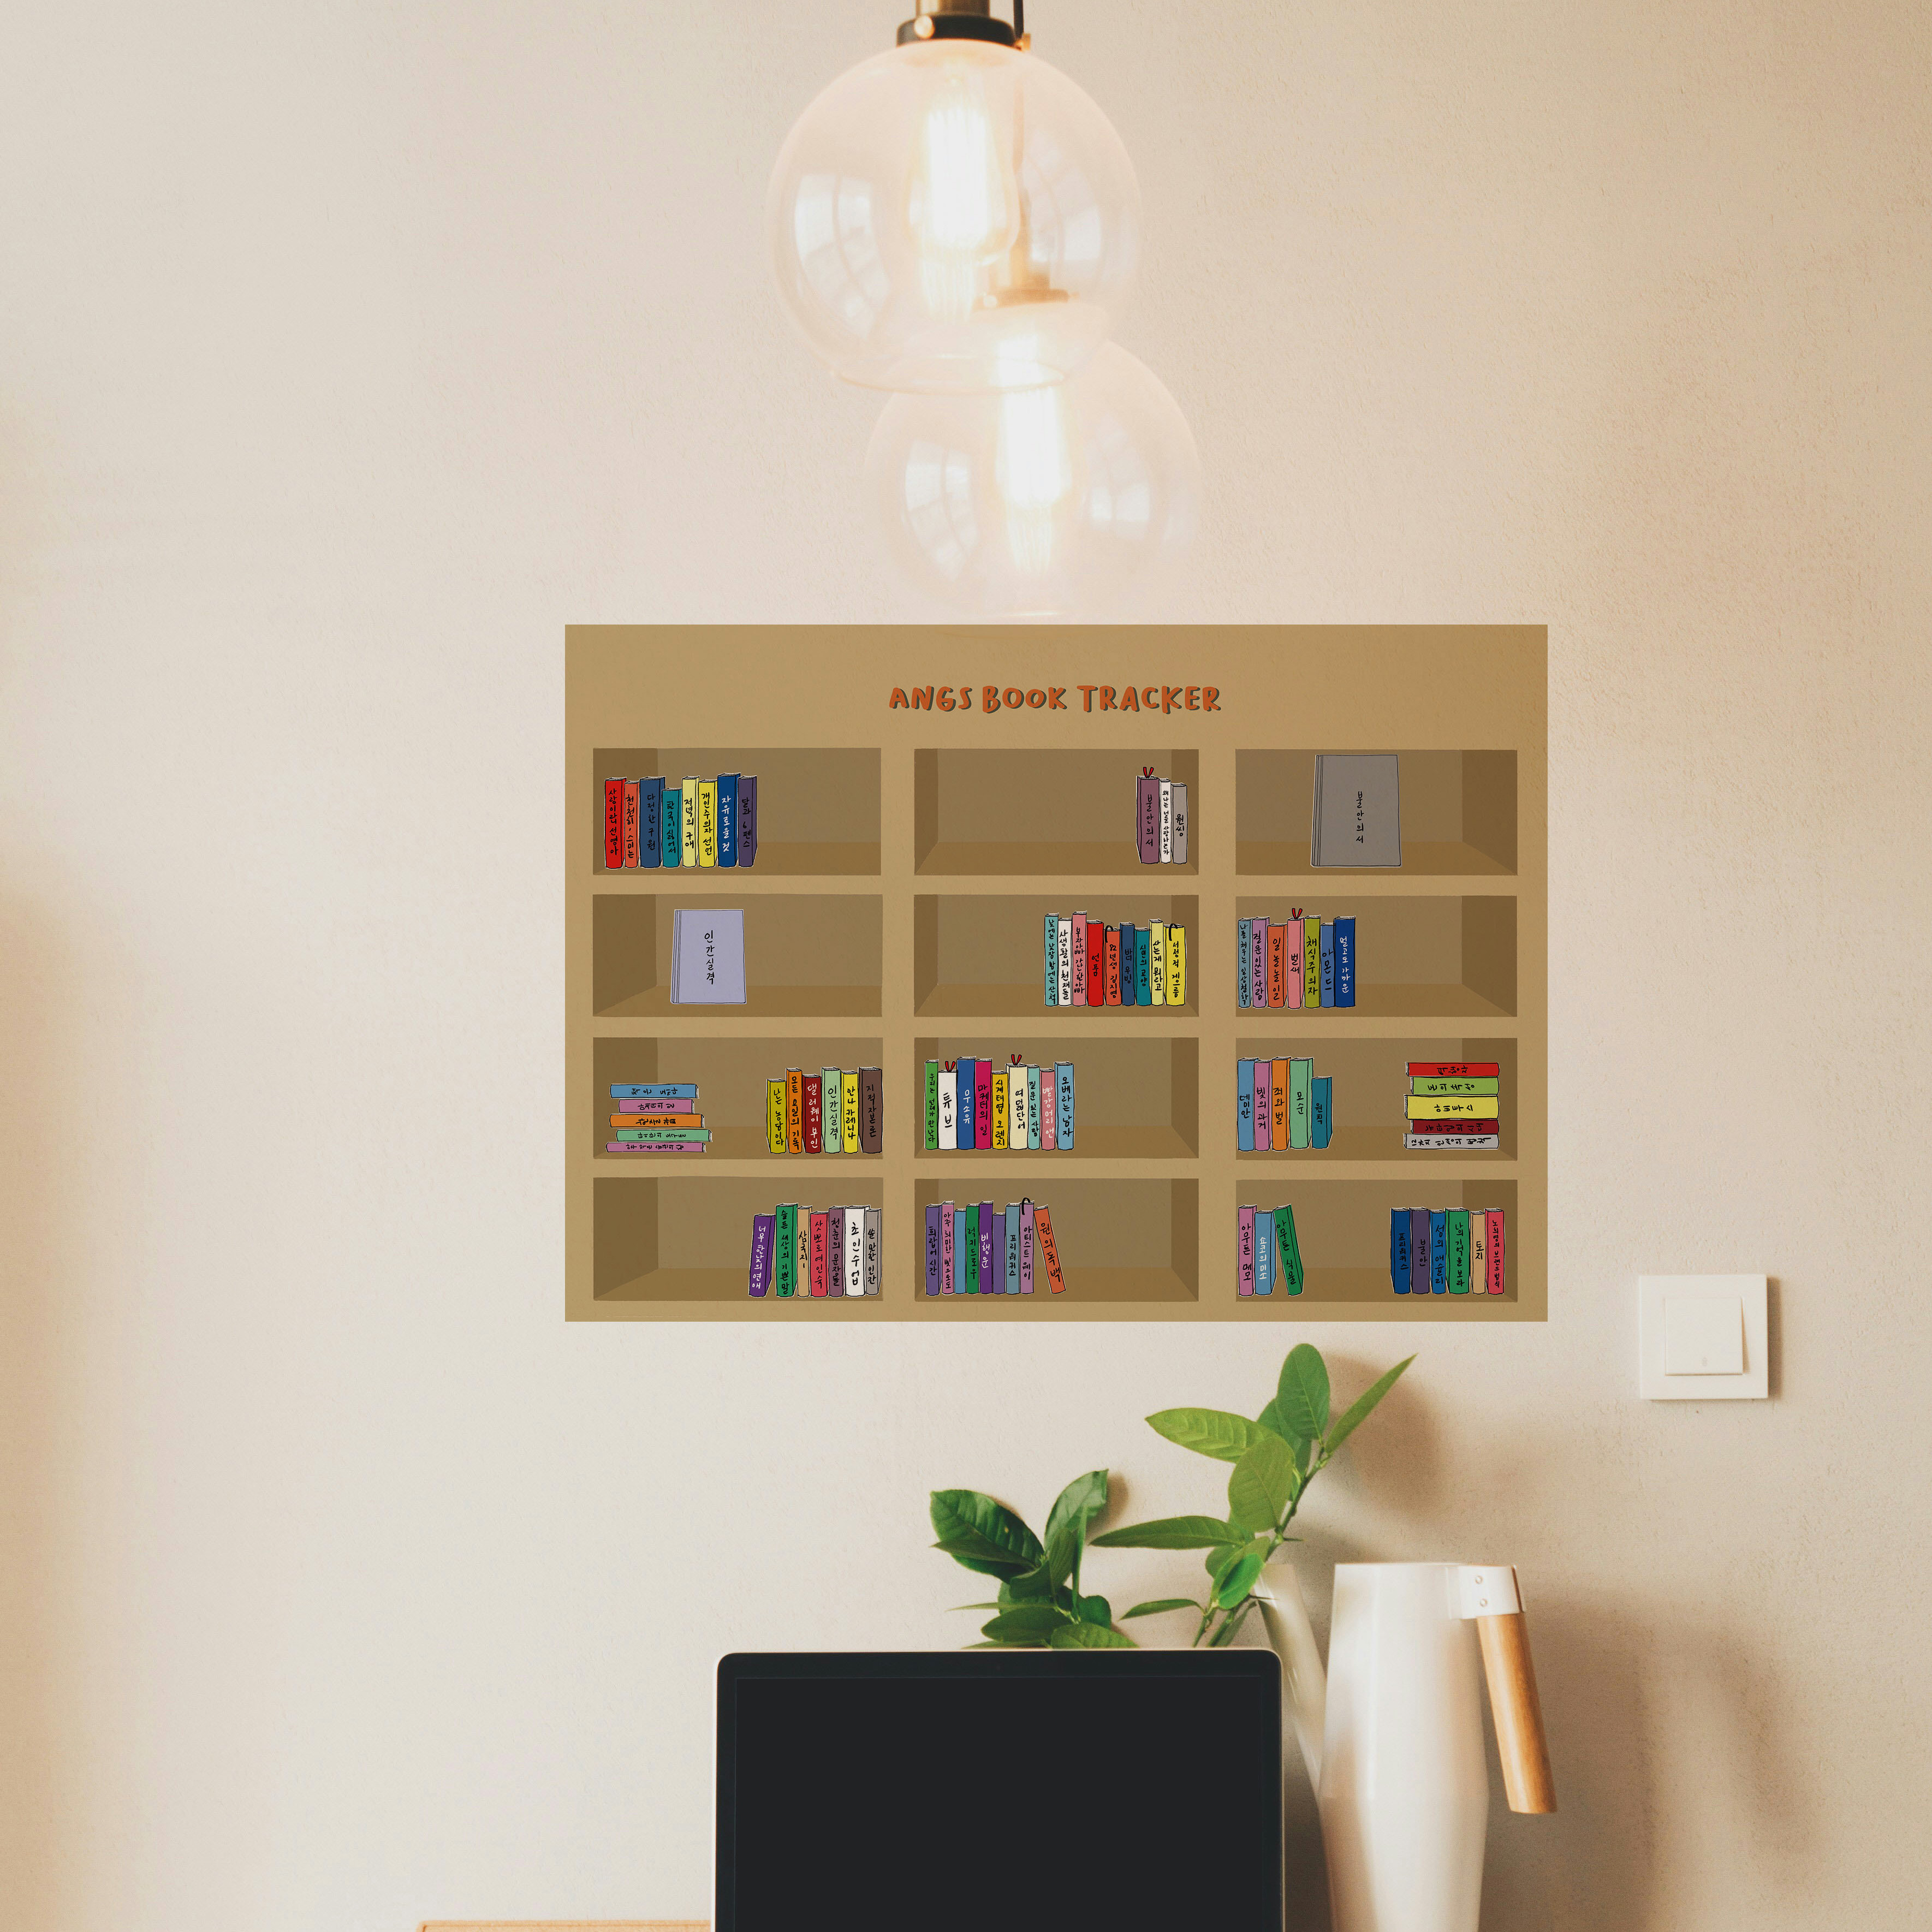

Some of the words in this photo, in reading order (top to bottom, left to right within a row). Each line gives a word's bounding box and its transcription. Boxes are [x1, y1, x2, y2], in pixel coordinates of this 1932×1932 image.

[888, 685, 974, 712] ANGS
[982, 685, 1068, 714] BOOK
[1077, 686, 1222, 714] TRACKER
[609, 788, 617, 824] 사랑이라니
[684, 798, 693, 825] 저녁의
[702, 792, 712, 833] 개인주의자
[742, 797, 751, 815] 달과
[722, 795, 731, 839] 자유로울
[625, 835, 634, 859] 스미는
[685, 832, 694, 848] 구애
[703, 837, 712, 855] 선언
[723, 842, 729, 852] 것
[1240, 924, 1247, 938] 나를
[1060, 930, 1068, 966] 사생활의
[1291, 953, 1300, 974] 벌새
[1306, 936, 1318, 995] 채식주의자
[1322, 948, 1334, 990] 아몬드
[1061, 970, 1069, 1000] 천재들
[1342, 967, 1350, 993] 가까운
[1049, 986, 1055, 1004] 산책
[1437, 1065, 1467, 1075] 역행자
[792, 1077, 798, 1093] 모든
[847, 1086, 855, 1104] 안나
[1062, 1077, 1072, 1111] 오베라는
[774, 1088, 782, 1104] 나는
[978, 1084, 989, 1120] 마케터의
[1240, 1094, 1250, 1119] 데미안
[1257, 1087, 1266, 1108] 빛의
[1297, 1092, 1304, 1114] 모순
[943, 1092, 952, 1128] 튜브
[775, 1111, 784, 1145] 농담이다
[846, 1109, 856, 1139] 카레니나
[980, 1125, 987, 1136] 일
[1063, 1115, 1073, 1137] 남자
[1258, 1114, 1267, 1129] 과거
[1467, 1123, 1483, 1132] 시대
[793, 1130, 799, 1150] 기록
[811, 1127, 818, 1148] 부인
[995, 1120, 1004, 1145] 오렌지
[781, 1210, 788, 1229] 슬픈
[944, 1212, 951, 1227] 아주
[1455, 1222, 1463, 1236] 나의
[758, 1226, 765, 1242] 너무
[831, 1218, 840, 1249] 청춘의
[1024, 1225, 1033, 1258] 아티스트
[781, 1234, 789, 1258] 세상의
[981, 1233, 990, 1268] 비행운
[1418, 1239, 1427, 1267] 불안
[1476, 1241, 1484, 1259] 토지
[832, 1254, 841, 1286] 문장들
[867, 1265, 876, 1284] 인간
[930, 1259, 938, 1276] 시간
[1023, 1262, 1030, 1280] 웨이
[1243, 1264, 1251, 1281] 메모
[752, 1273, 761, 1289] 연애
[1457, 1270, 1465, 1287] 보라
